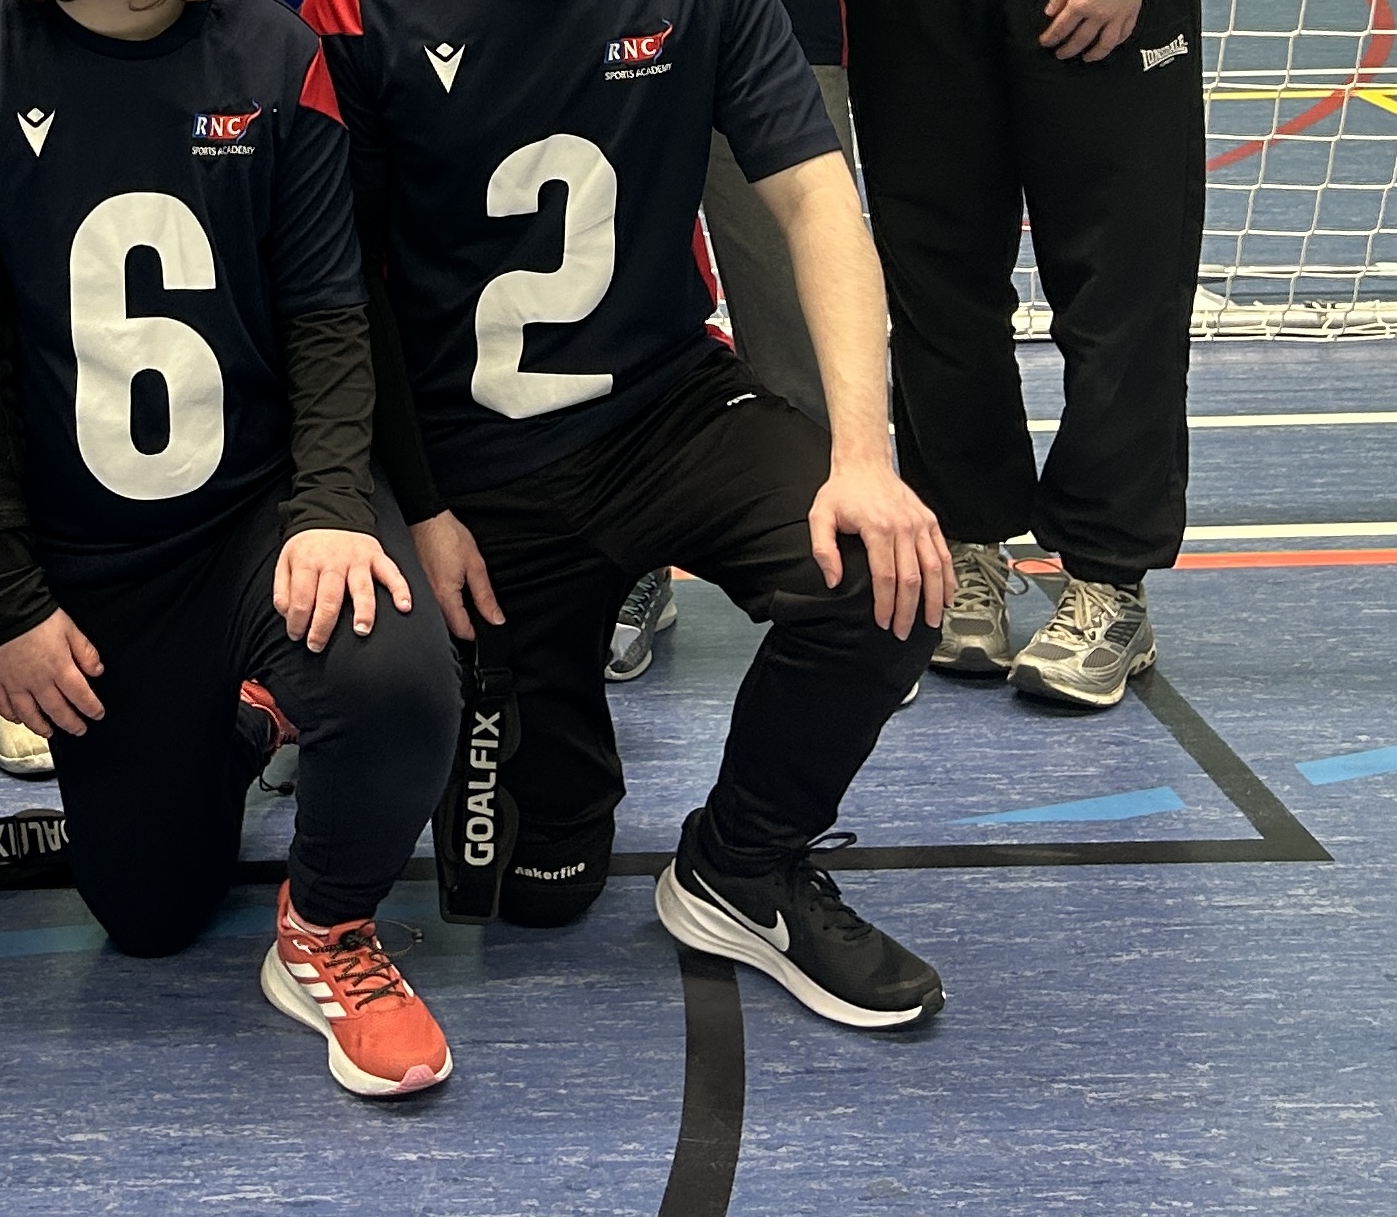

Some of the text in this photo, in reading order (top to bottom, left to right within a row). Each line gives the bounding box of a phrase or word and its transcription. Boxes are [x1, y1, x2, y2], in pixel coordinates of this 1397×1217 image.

[608, 38, 657, 61] RNC
[604, 62, 673, 81] SPORTS ACADEMY
[195, 116, 242, 137] RNC
[191, 144, 256, 157] SPORTS ACADEMY
[470, 133, 618, 419] 2
[69, 191, 225, 501] 6
[463, 710, 501, 867] GOALFIX
